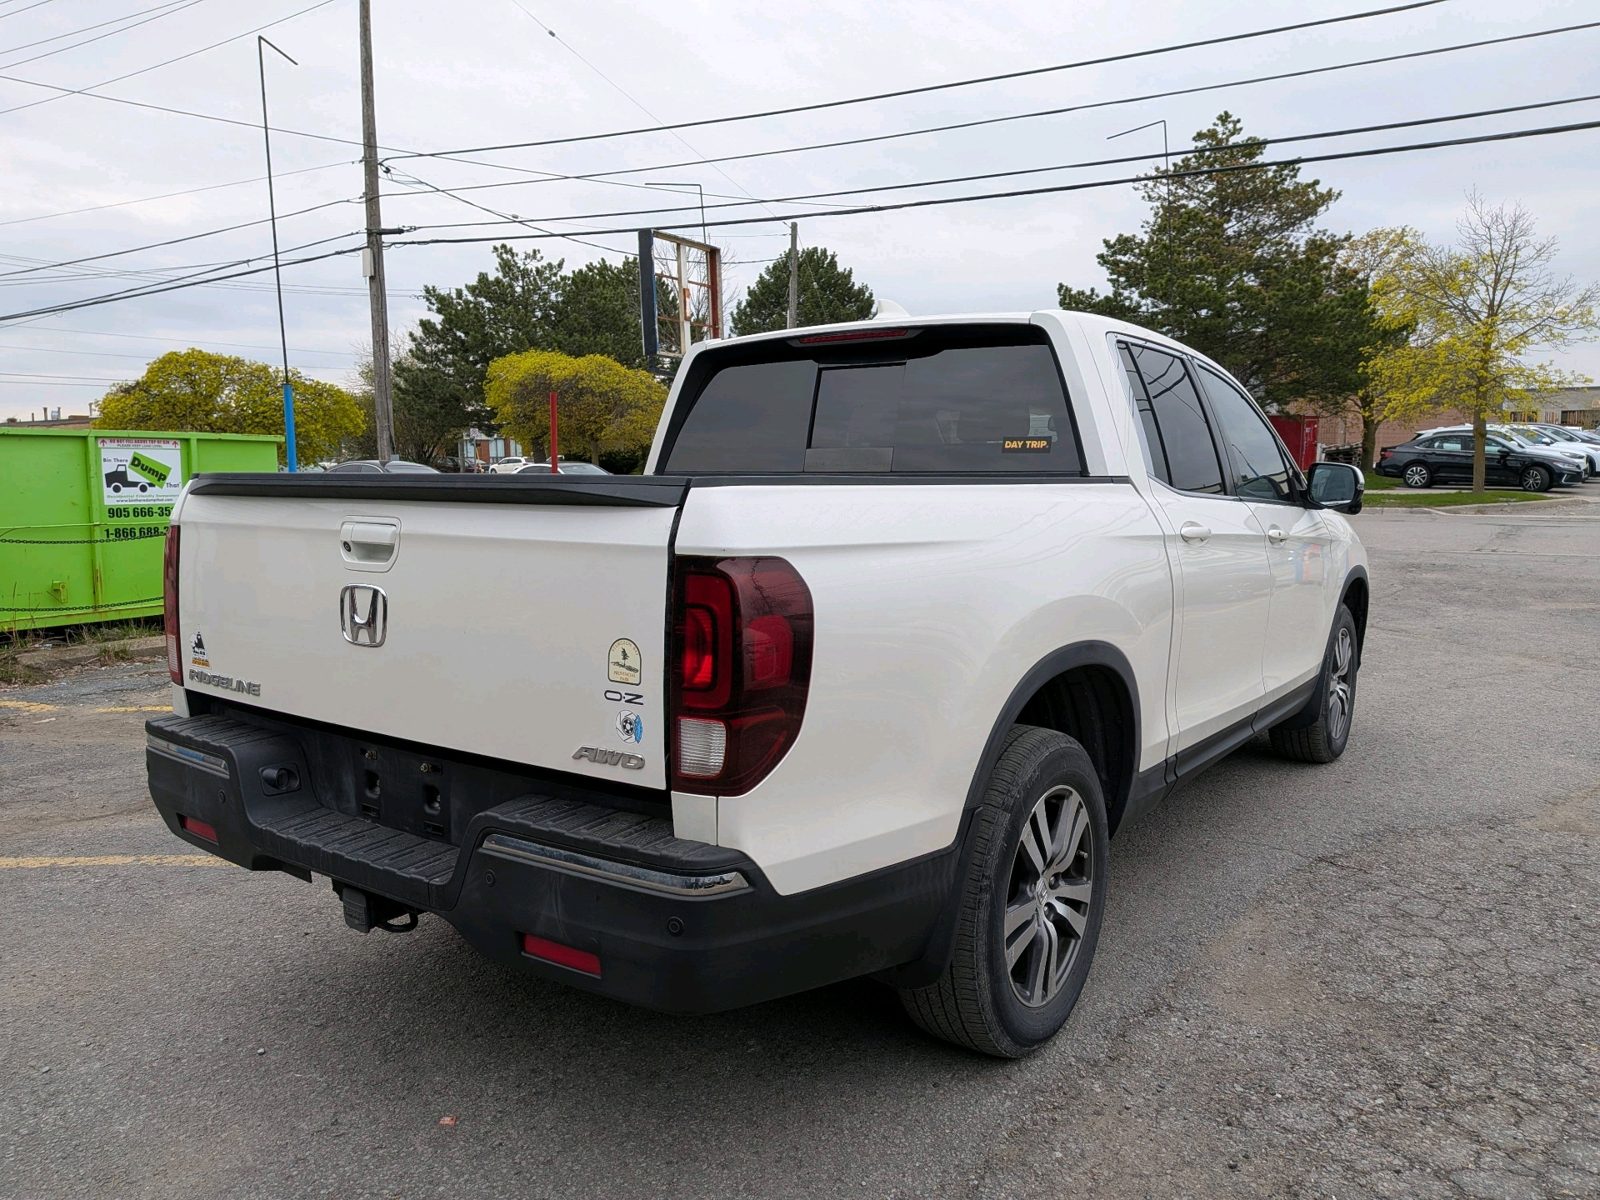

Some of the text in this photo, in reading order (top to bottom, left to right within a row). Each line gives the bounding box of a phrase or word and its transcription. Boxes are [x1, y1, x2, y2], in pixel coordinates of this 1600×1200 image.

[1004, 440, 1024, 449] DAY
[130, 456, 168, 483] Dump
[107, 507, 130, 519] 905
[104, 527, 137, 539] 1-866
[188, 668, 261, 697] RIDGELINE
[571, 745, 646, 770] AWD
